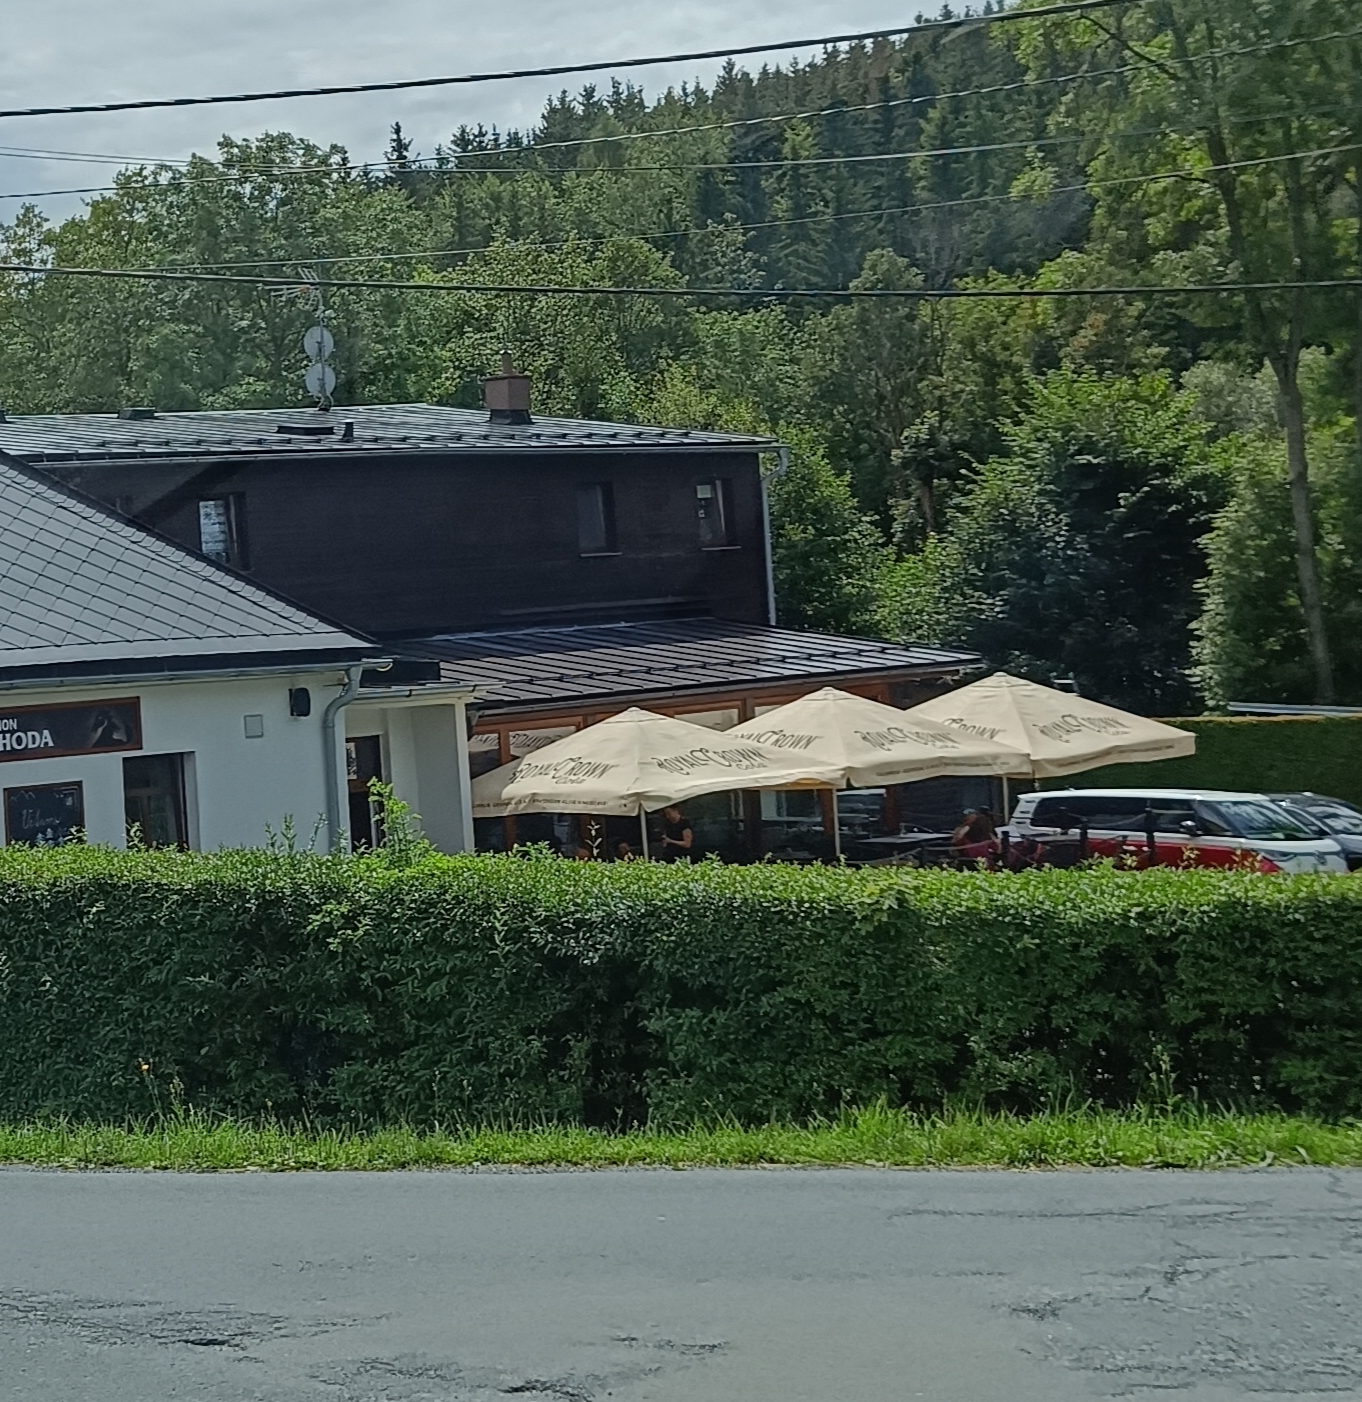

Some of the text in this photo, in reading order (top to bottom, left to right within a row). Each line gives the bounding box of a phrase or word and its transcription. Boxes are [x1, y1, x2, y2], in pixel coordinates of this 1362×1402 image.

[551, 756, 620, 780] CROWN
[651, 747, 770, 776] ROYAL CROWN
